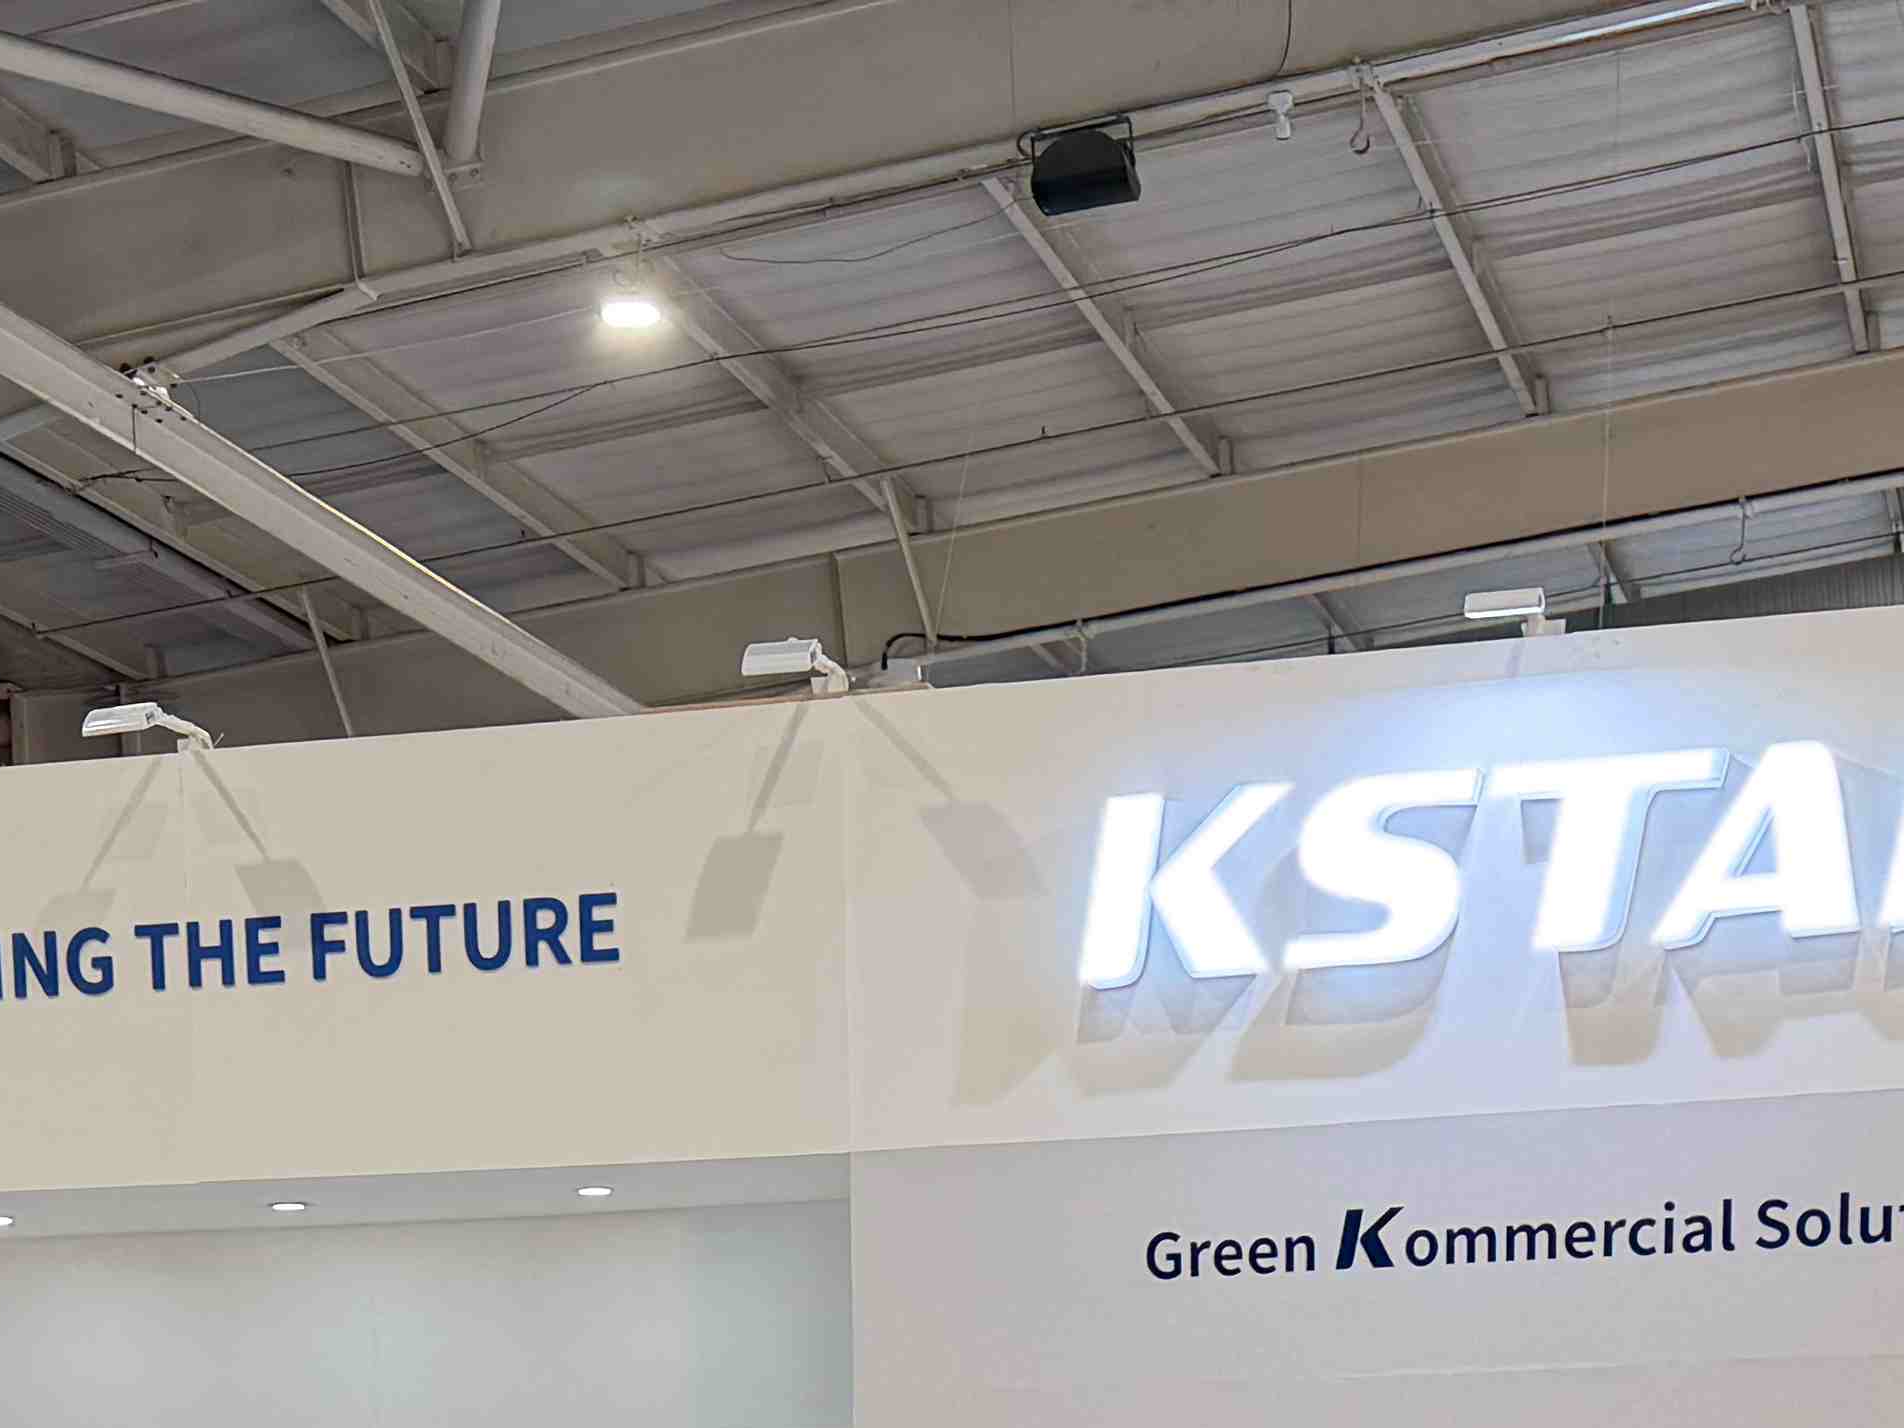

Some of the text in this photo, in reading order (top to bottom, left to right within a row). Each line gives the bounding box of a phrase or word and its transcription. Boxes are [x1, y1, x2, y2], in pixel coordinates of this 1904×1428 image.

[136, 915, 286, 991] THE
[309, 892, 620, 982] FUTURE
[1145, 1231, 1317, 1281] Green
[1334, 1199, 1734, 1272] Kommercial
